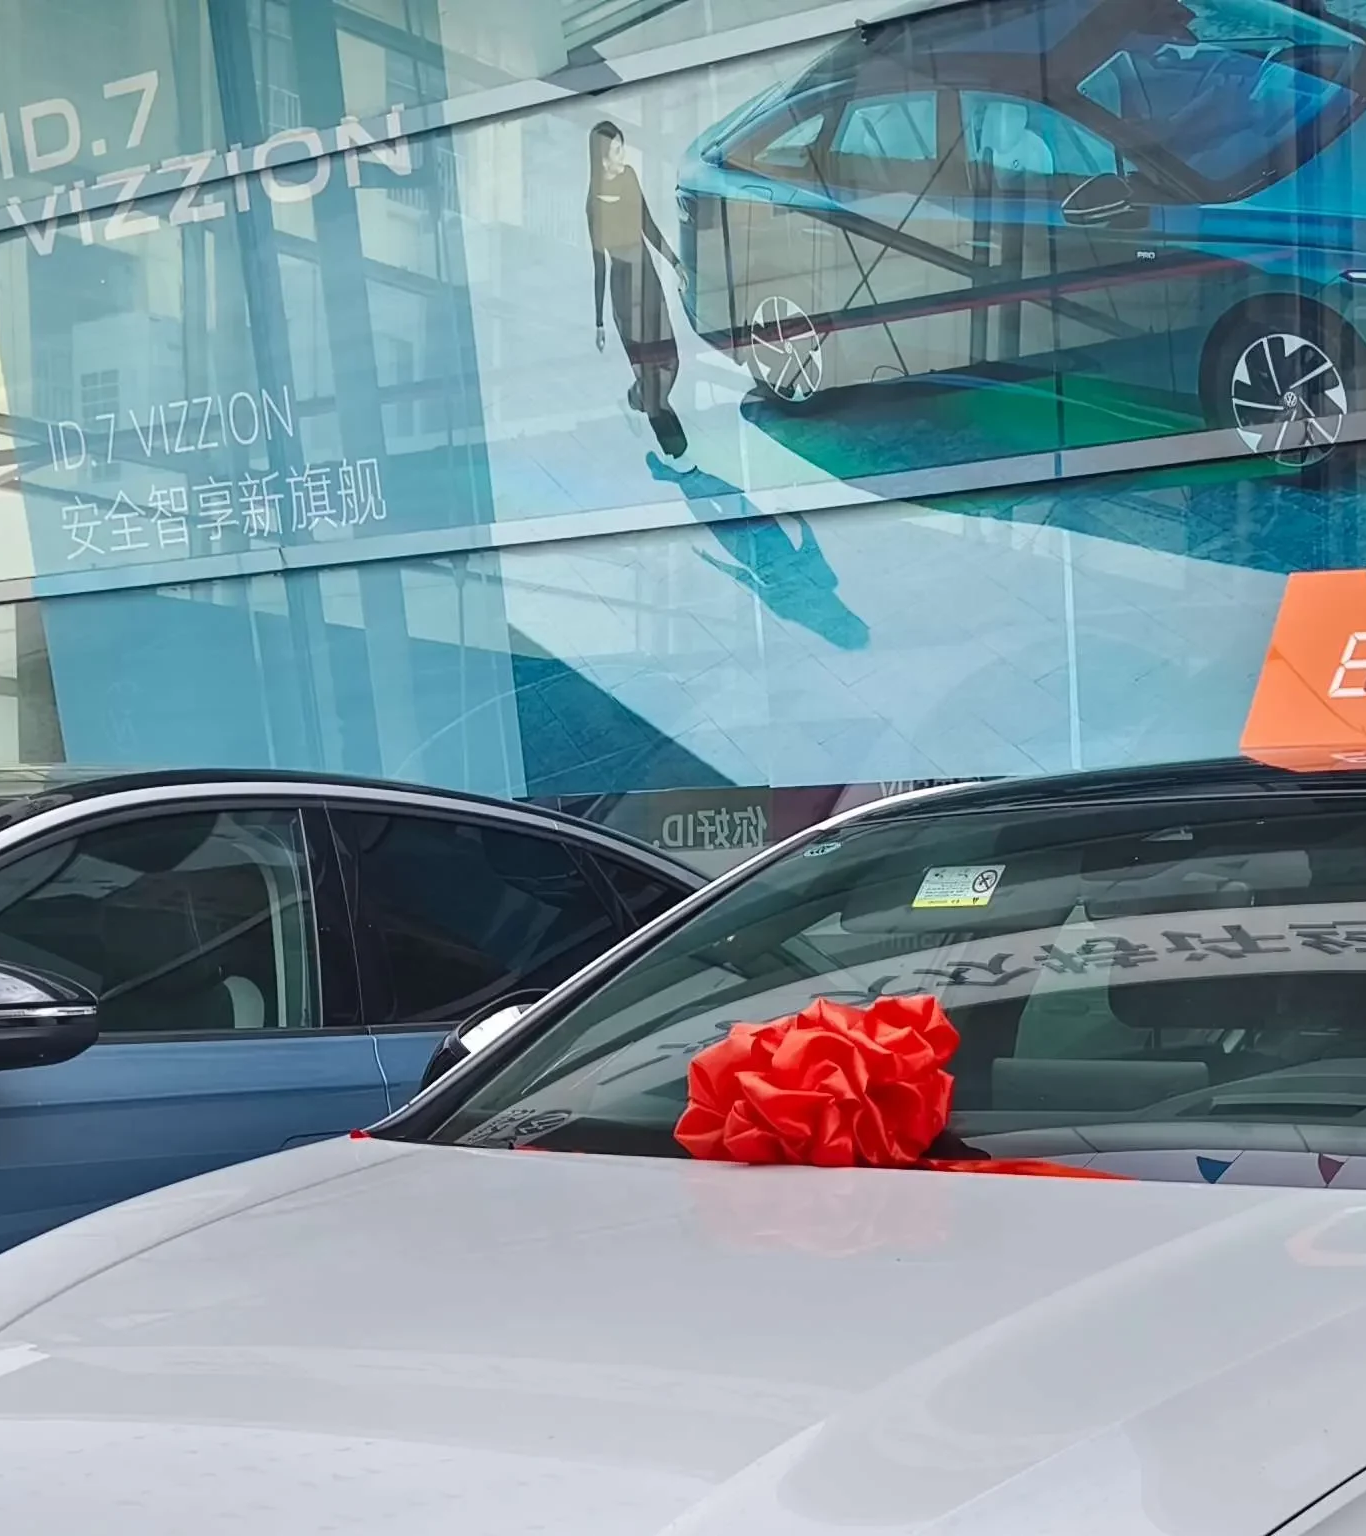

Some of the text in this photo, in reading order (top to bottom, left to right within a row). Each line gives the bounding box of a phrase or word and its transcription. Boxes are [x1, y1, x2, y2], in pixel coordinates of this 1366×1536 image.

[8, 104, 412, 257] VIZZION
[129, 385, 295, 457] VIZZION
[61, 458, 387, 560] 安全智享新旗舰
